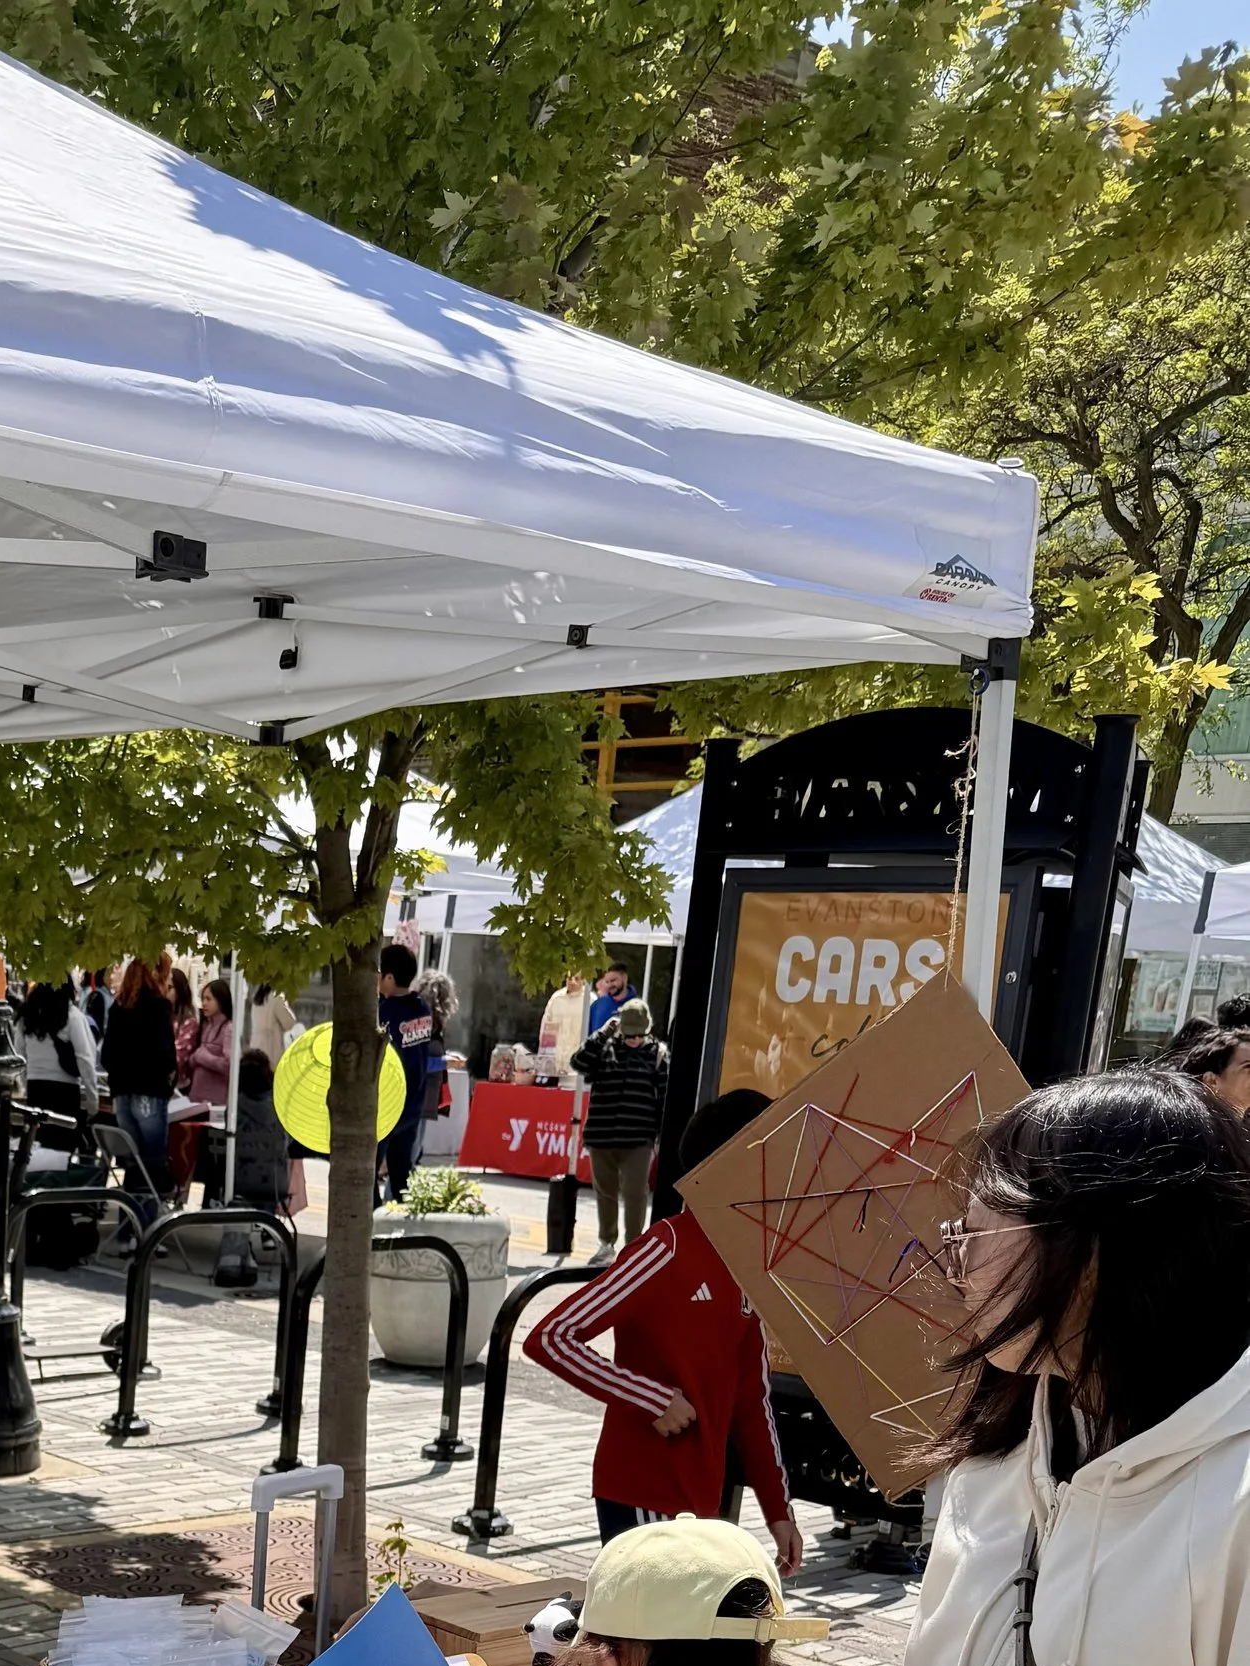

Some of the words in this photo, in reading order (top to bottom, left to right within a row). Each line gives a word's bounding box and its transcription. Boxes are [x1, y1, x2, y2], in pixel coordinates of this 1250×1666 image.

[935, 578, 982, 591] CANOPY
[785, 898, 953, 926] EVANSTON
[775, 935, 945, 1007] CARS
